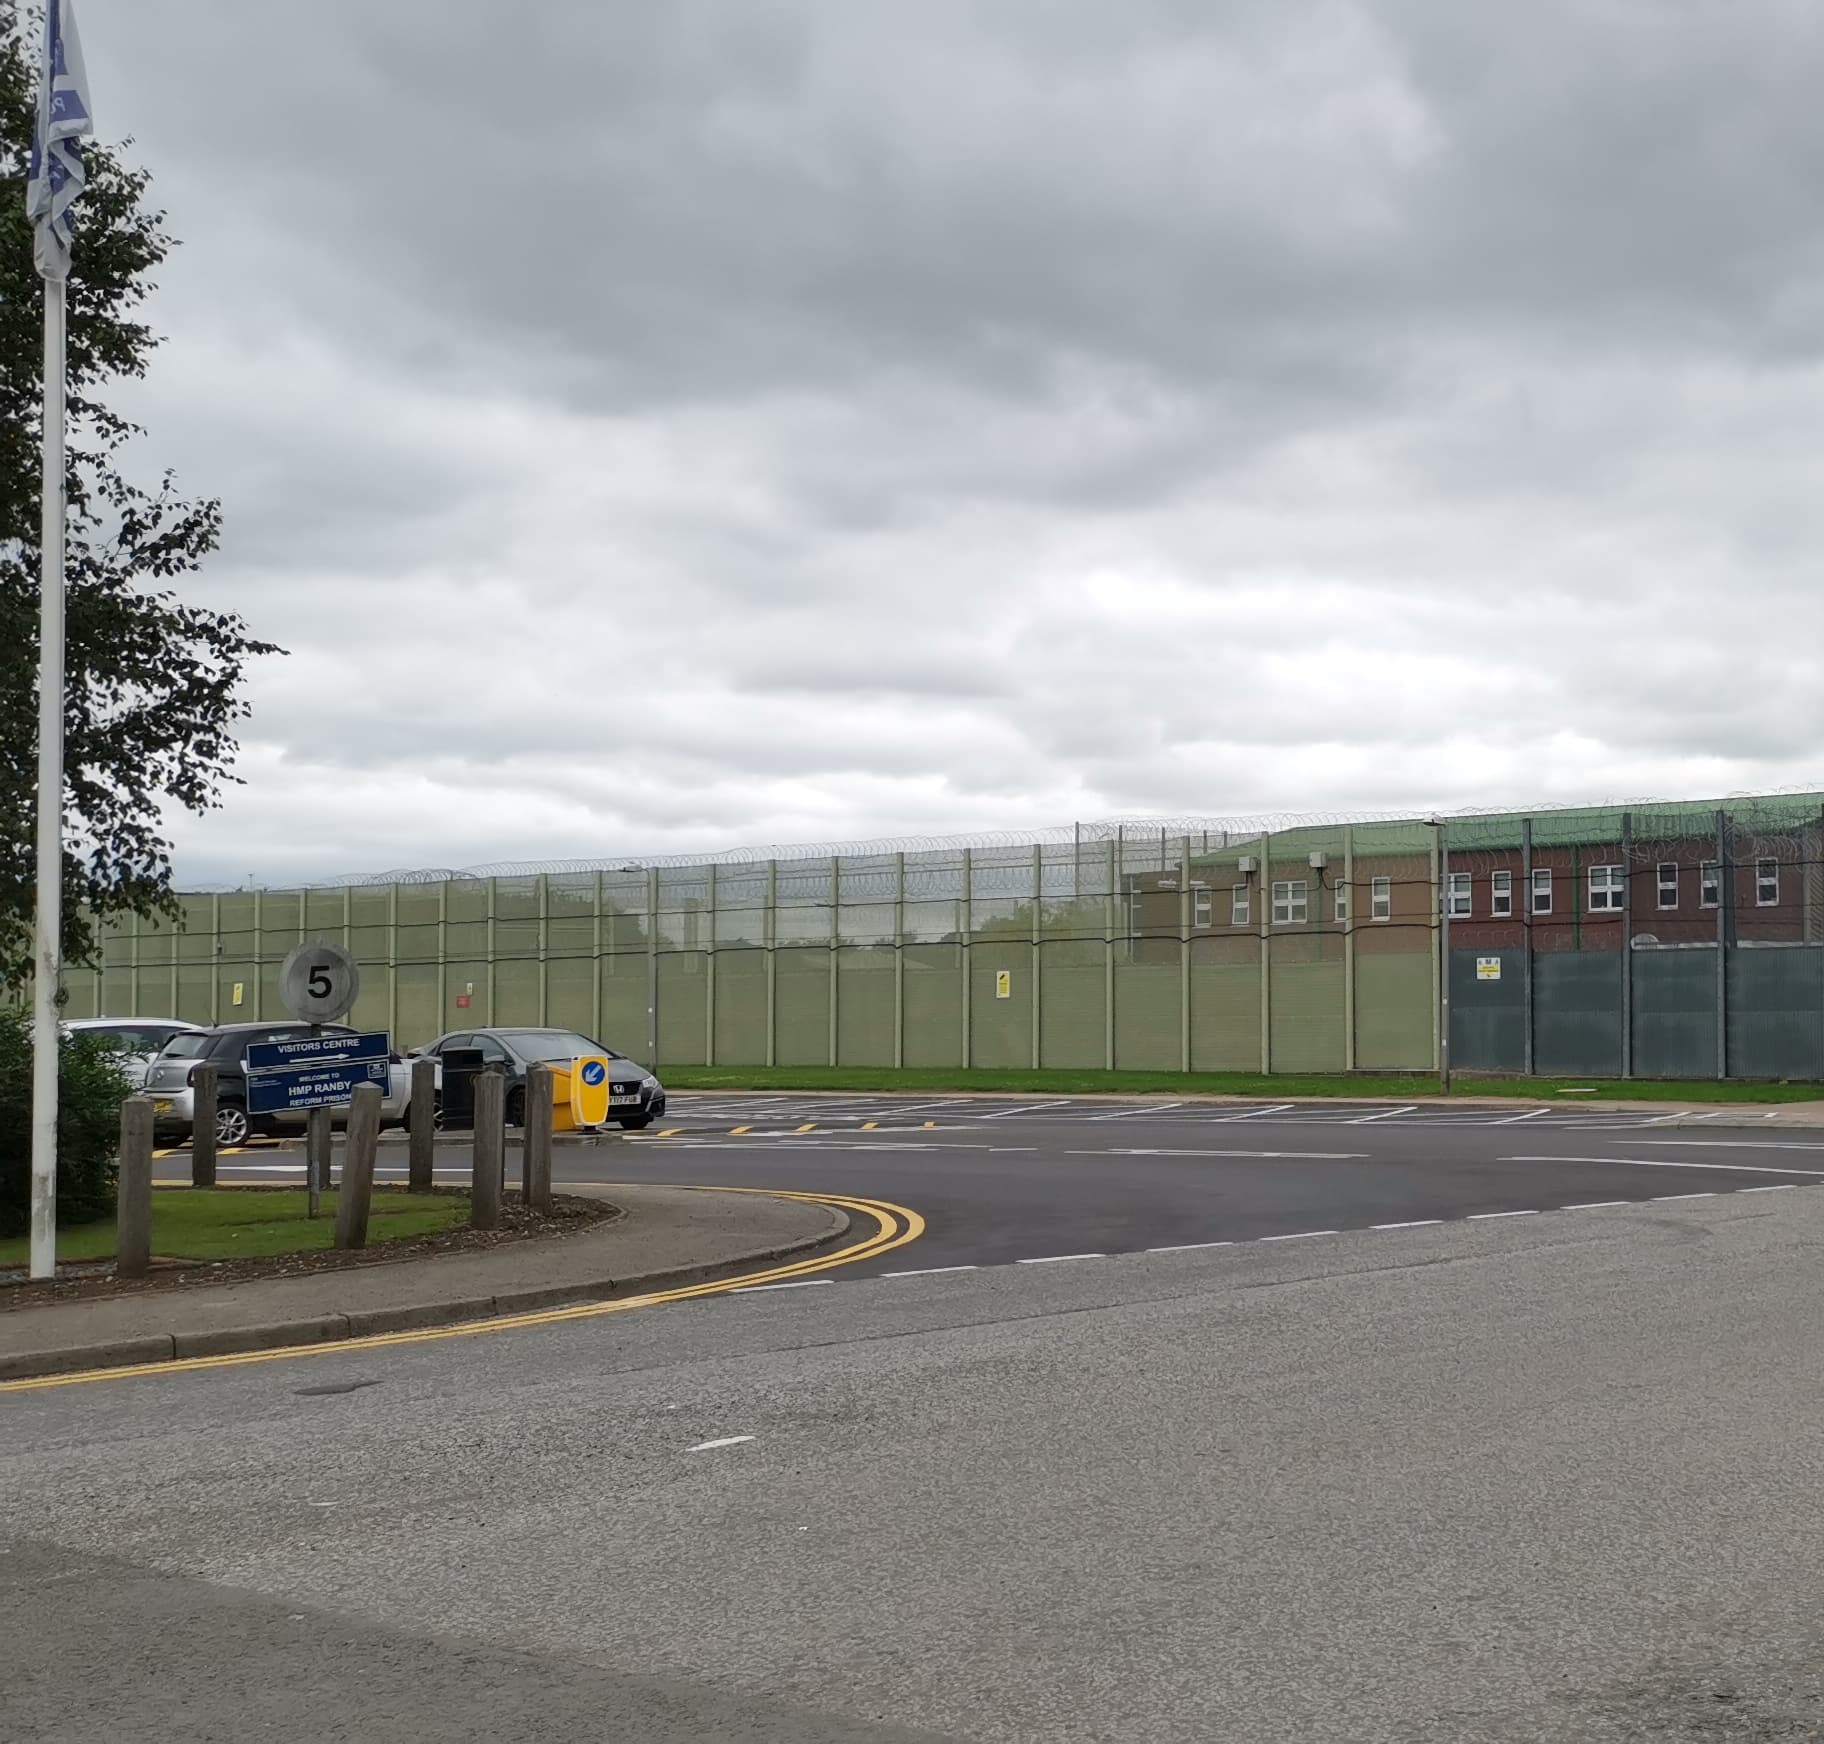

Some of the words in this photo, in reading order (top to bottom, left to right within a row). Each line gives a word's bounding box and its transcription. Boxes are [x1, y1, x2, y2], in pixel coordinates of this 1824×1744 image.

[307, 965, 332, 999] 5
[278, 1041, 321, 1054] VISITORS
[323, 1038, 361, 1050] CENTRE
[299, 1073, 330, 1082] WELCOME
[288, 1084, 313, 1097] HMP
[314, 1080, 352, 1093] RANBY
[289, 1097, 322, 1107] REFORM
[323, 1093, 352, 1103] PRISON
